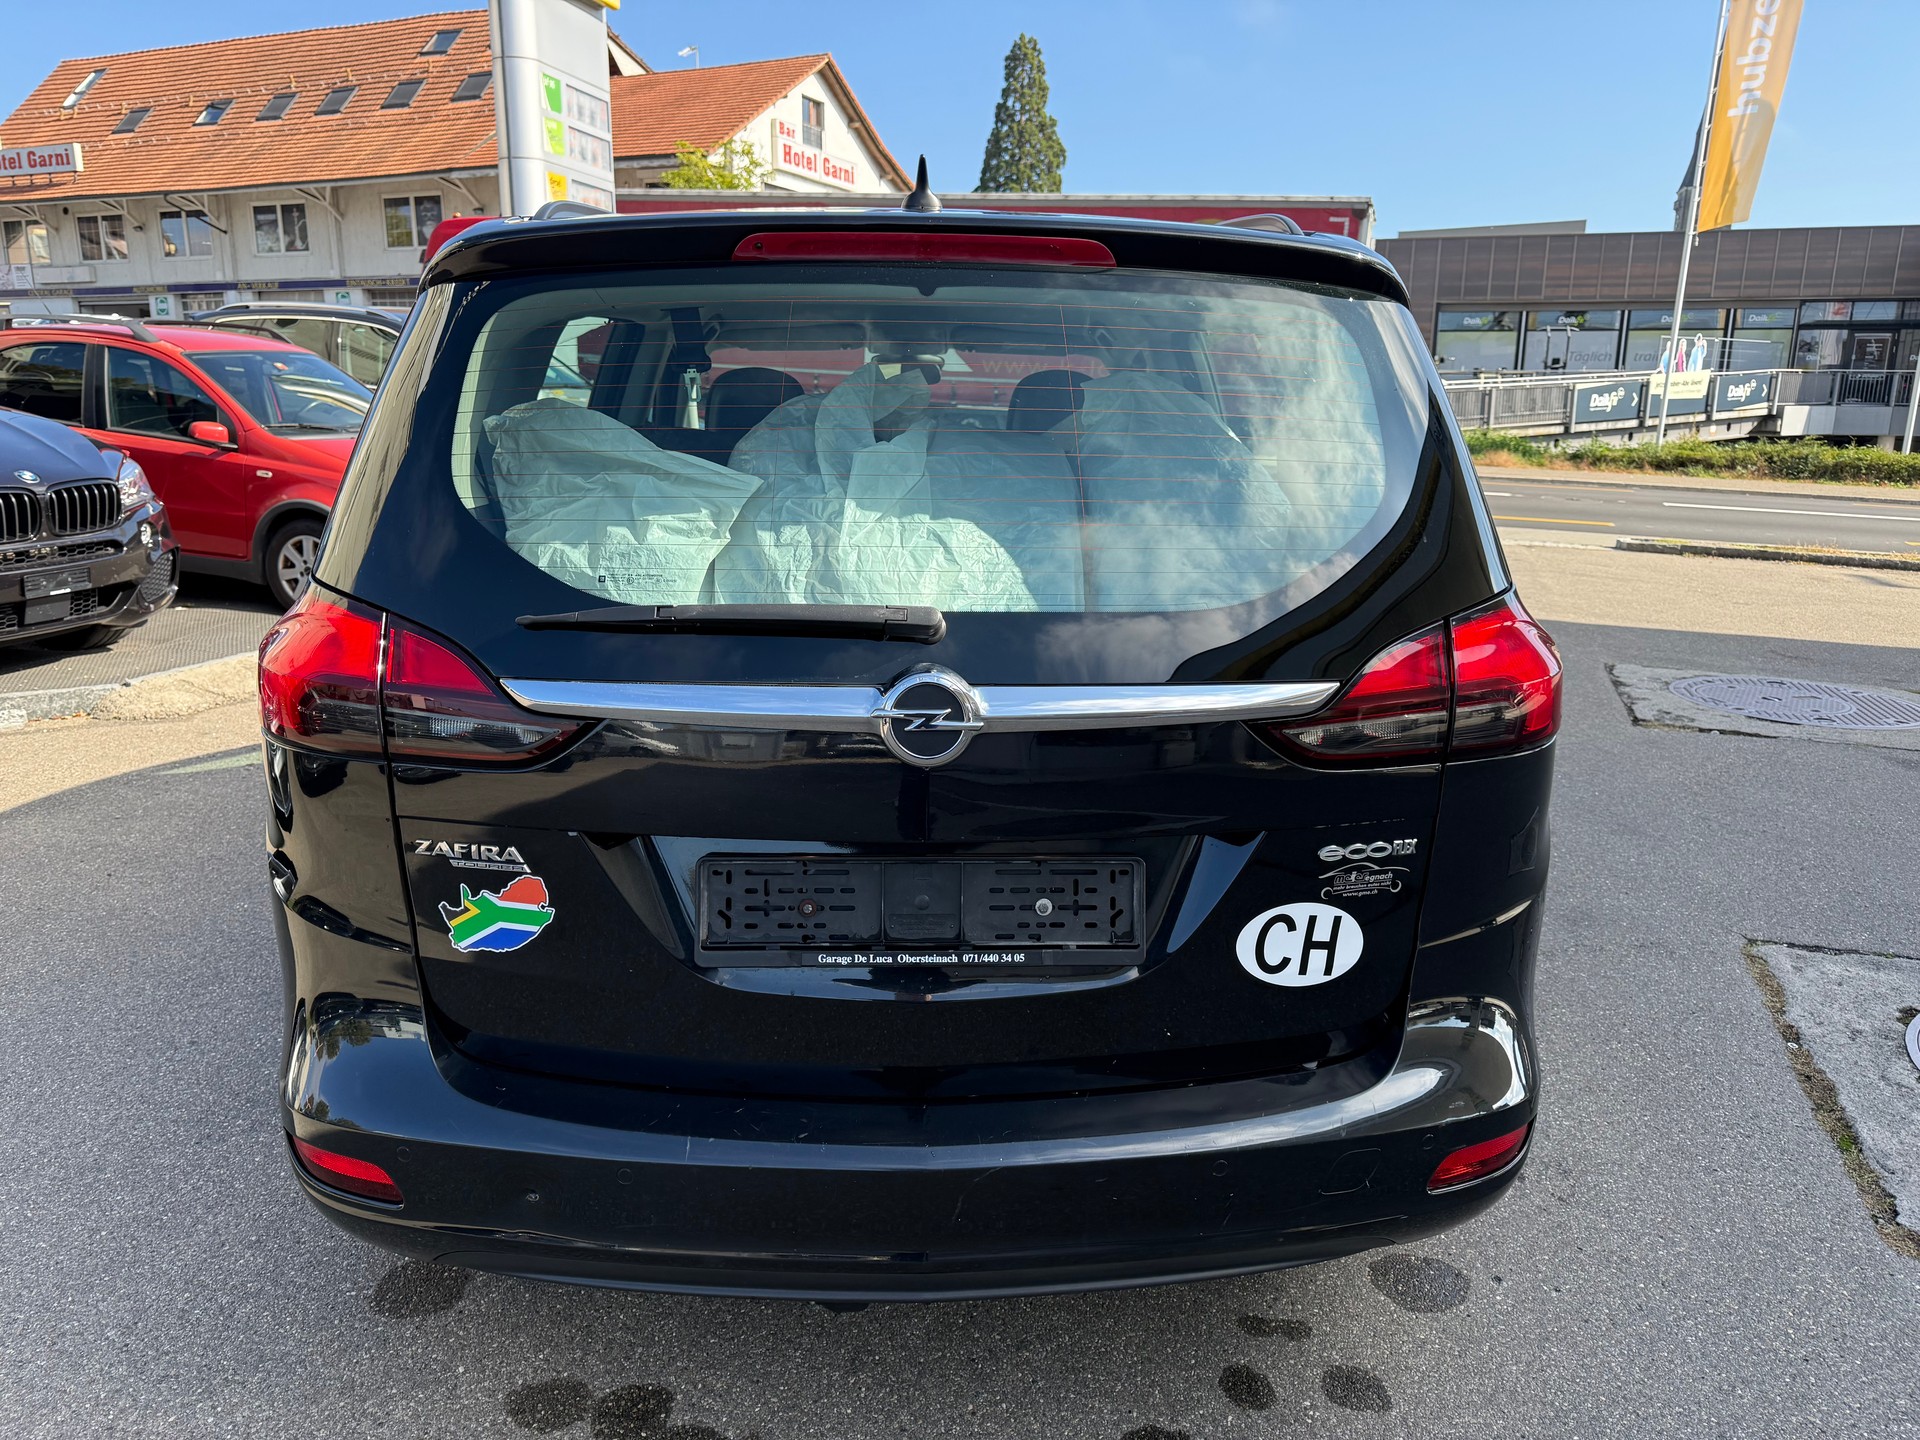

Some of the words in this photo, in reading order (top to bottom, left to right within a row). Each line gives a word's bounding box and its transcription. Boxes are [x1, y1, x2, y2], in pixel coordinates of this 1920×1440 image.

[1728, 0, 1780, 117] hubze
[779, 121, 796, 139] Bar
[0, 152, 23, 171] tel
[27, 148, 71, 169] Garni
[783, 143, 818, 173] Hotel
[823, 157, 855, 185] Garni
[415, 839, 525, 864] ZAFIRA
[451, 860, 526, 872] TOURER
[1365, 871, 1393, 883] egnach
[1255, 913, 1342, 976] CH
[818, 954, 852, 965] Garage
[854, 954, 867, 963] De
[869, 954, 893, 963] Luca
[897, 953, 958, 963] Obersteinach
[963, 953, 999, 963] 071/440
[1001, 953, 1012, 963] 34
[1014, 953, 1025, 963] 05
